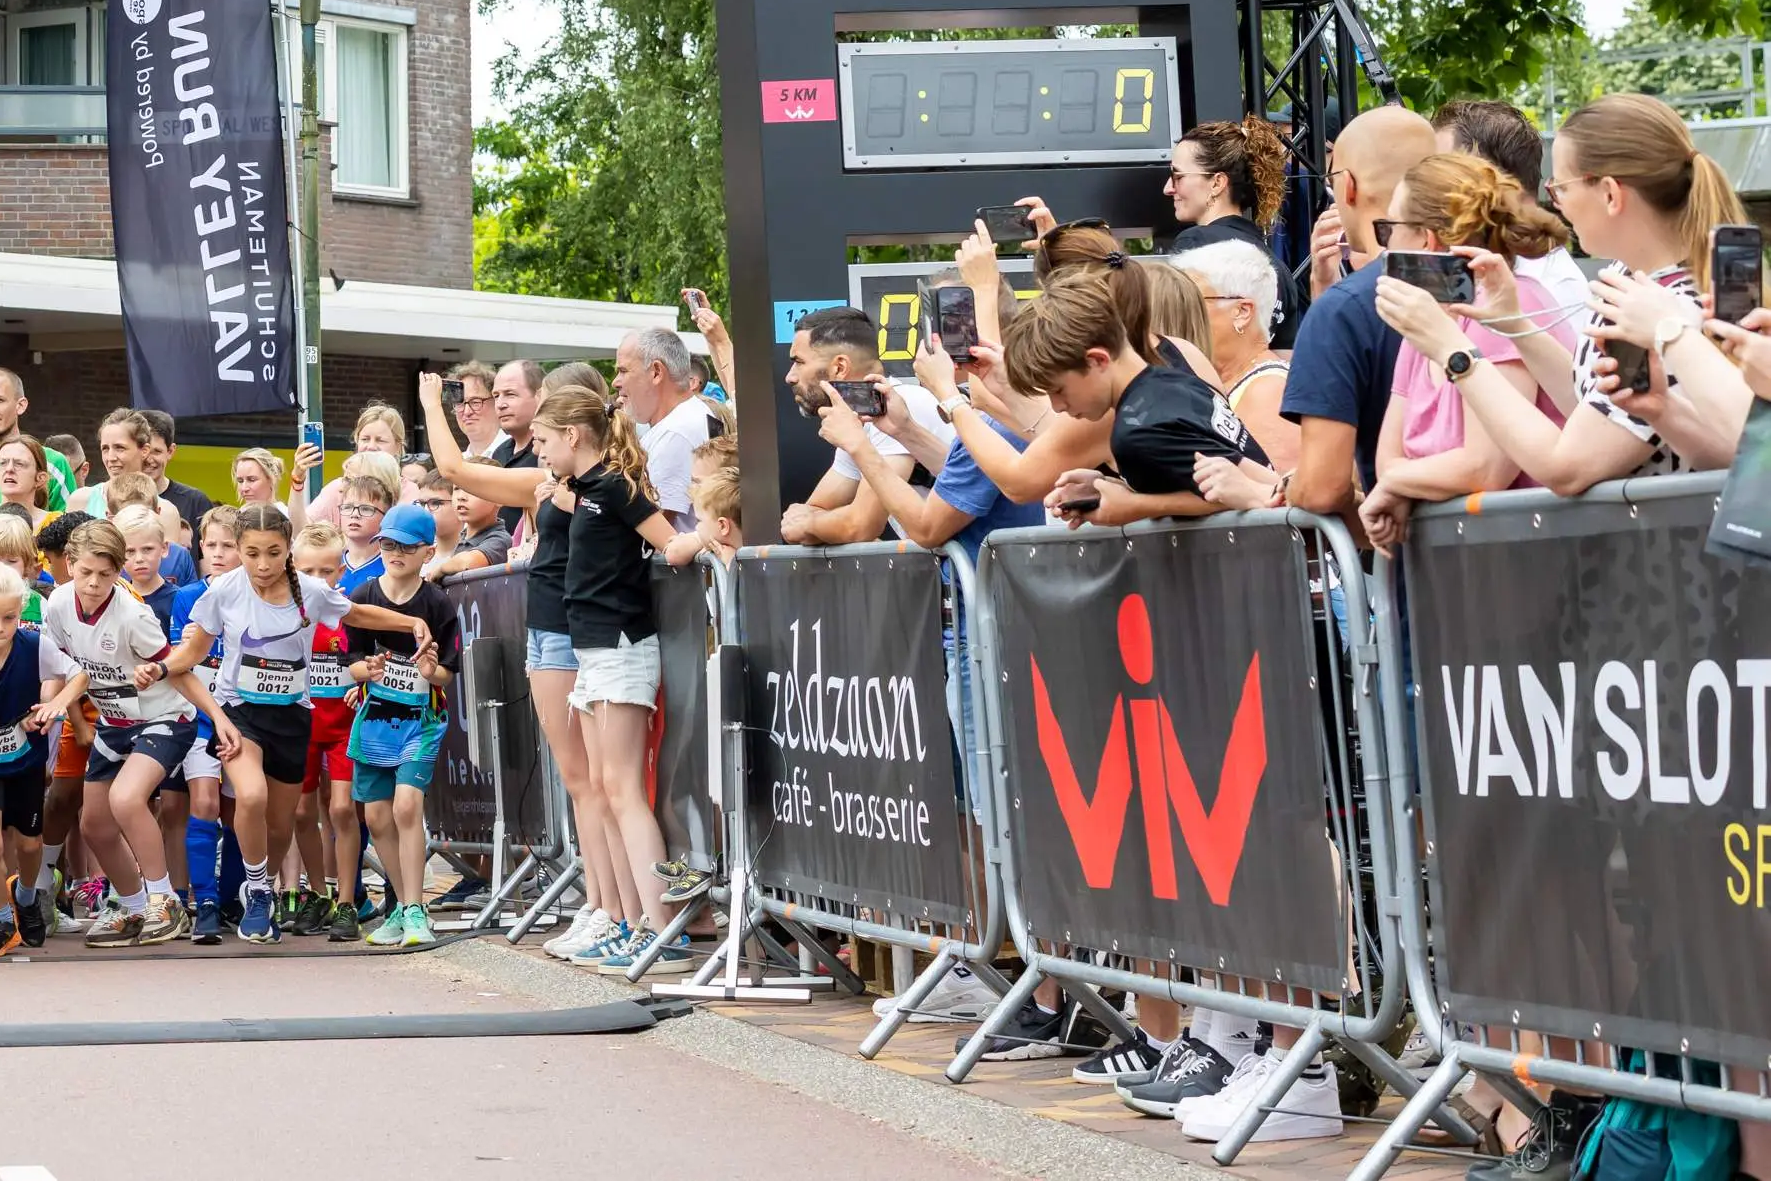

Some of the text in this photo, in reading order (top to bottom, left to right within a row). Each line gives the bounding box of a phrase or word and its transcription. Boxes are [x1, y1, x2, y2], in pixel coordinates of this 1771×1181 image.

[780, 87, 818, 101] 5 KM
[256, 671, 294, 682] Djenna
[384, 663, 419, 679] Charlie
[257, 682, 290, 694] 0012
[310, 675, 340, 686] 0021
[382, 676, 415, 692] 0054
[766, 619, 926, 763] zeldzaam
[1441, 660, 1576, 799] VAN
[772, 764, 813, 827] café
[829, 771, 931, 847] brasserie
